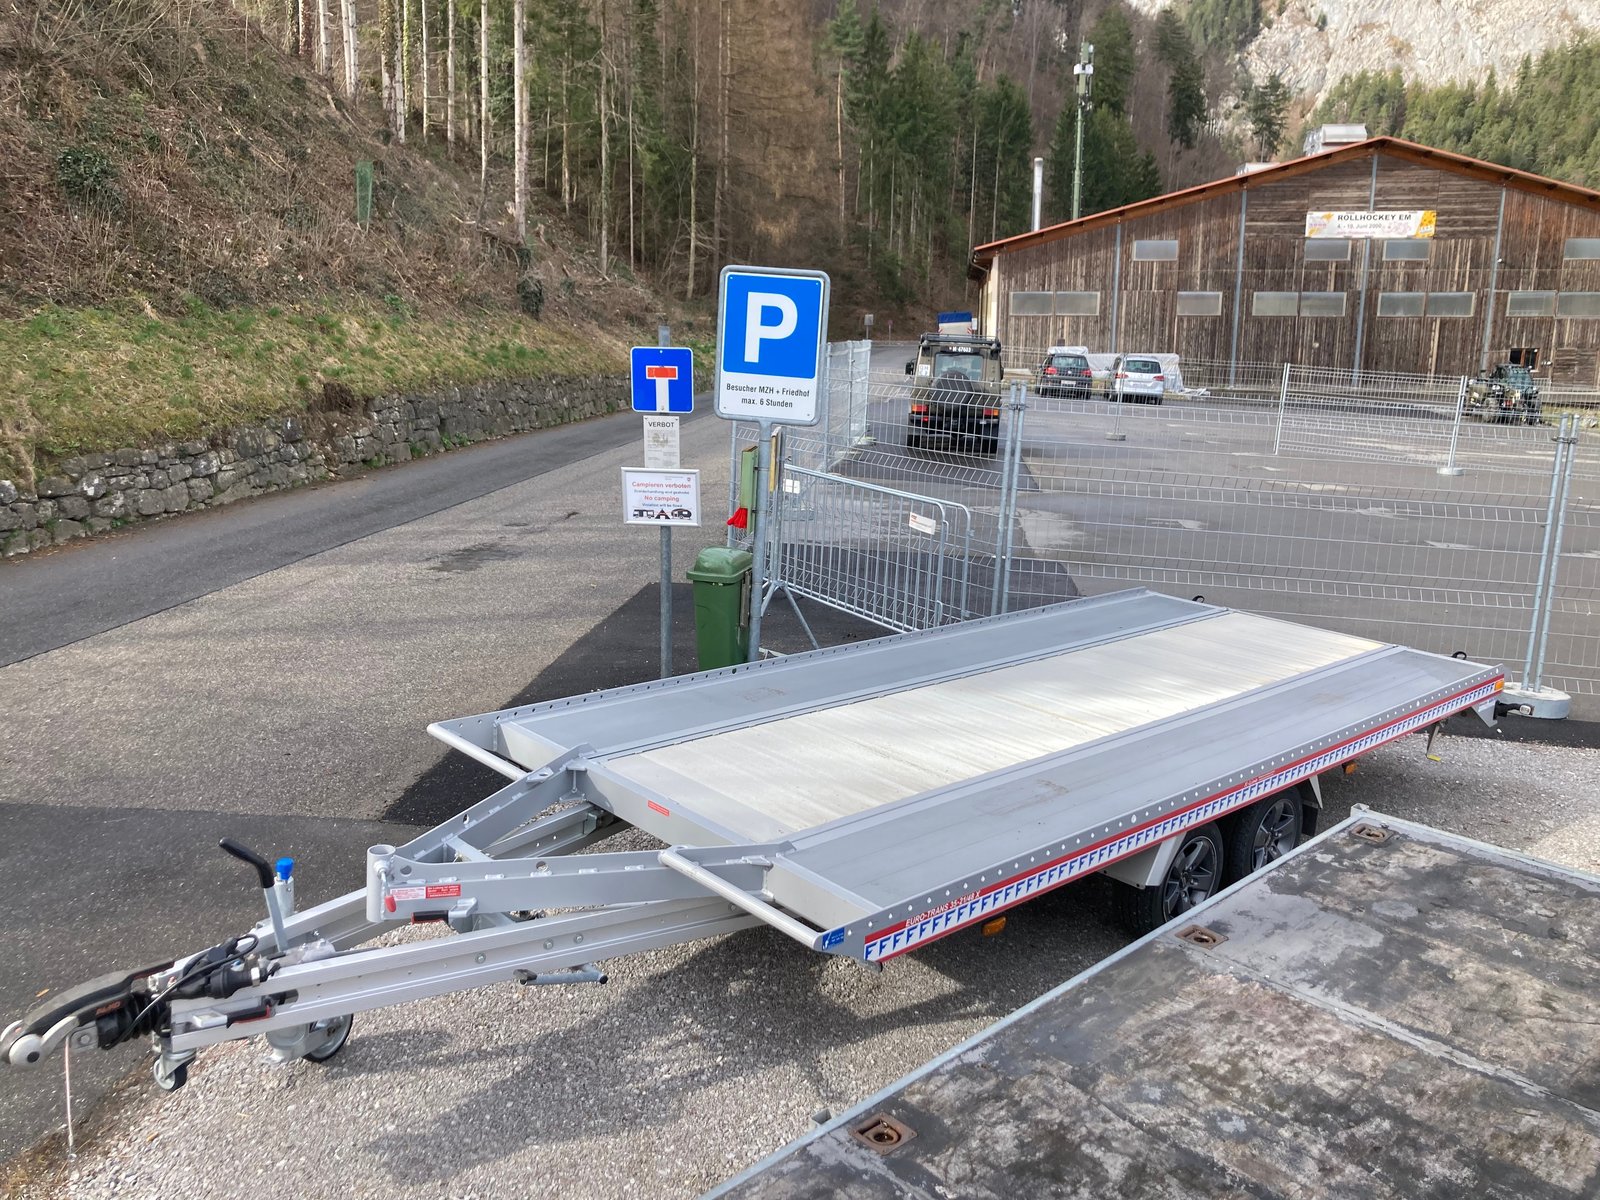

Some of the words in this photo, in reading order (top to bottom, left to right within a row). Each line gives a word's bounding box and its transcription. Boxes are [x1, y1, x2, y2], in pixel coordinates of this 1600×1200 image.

[744, 291, 798, 363] P
[726, 383, 757, 393] Besucher
[758, 386, 774, 394] MZH
[782, 387, 810, 397] Friedhof
[759, 398, 764, 406] 6
[766, 398, 793, 408] Stunden
[905, 903, 949, 928] EURO-TRANS
